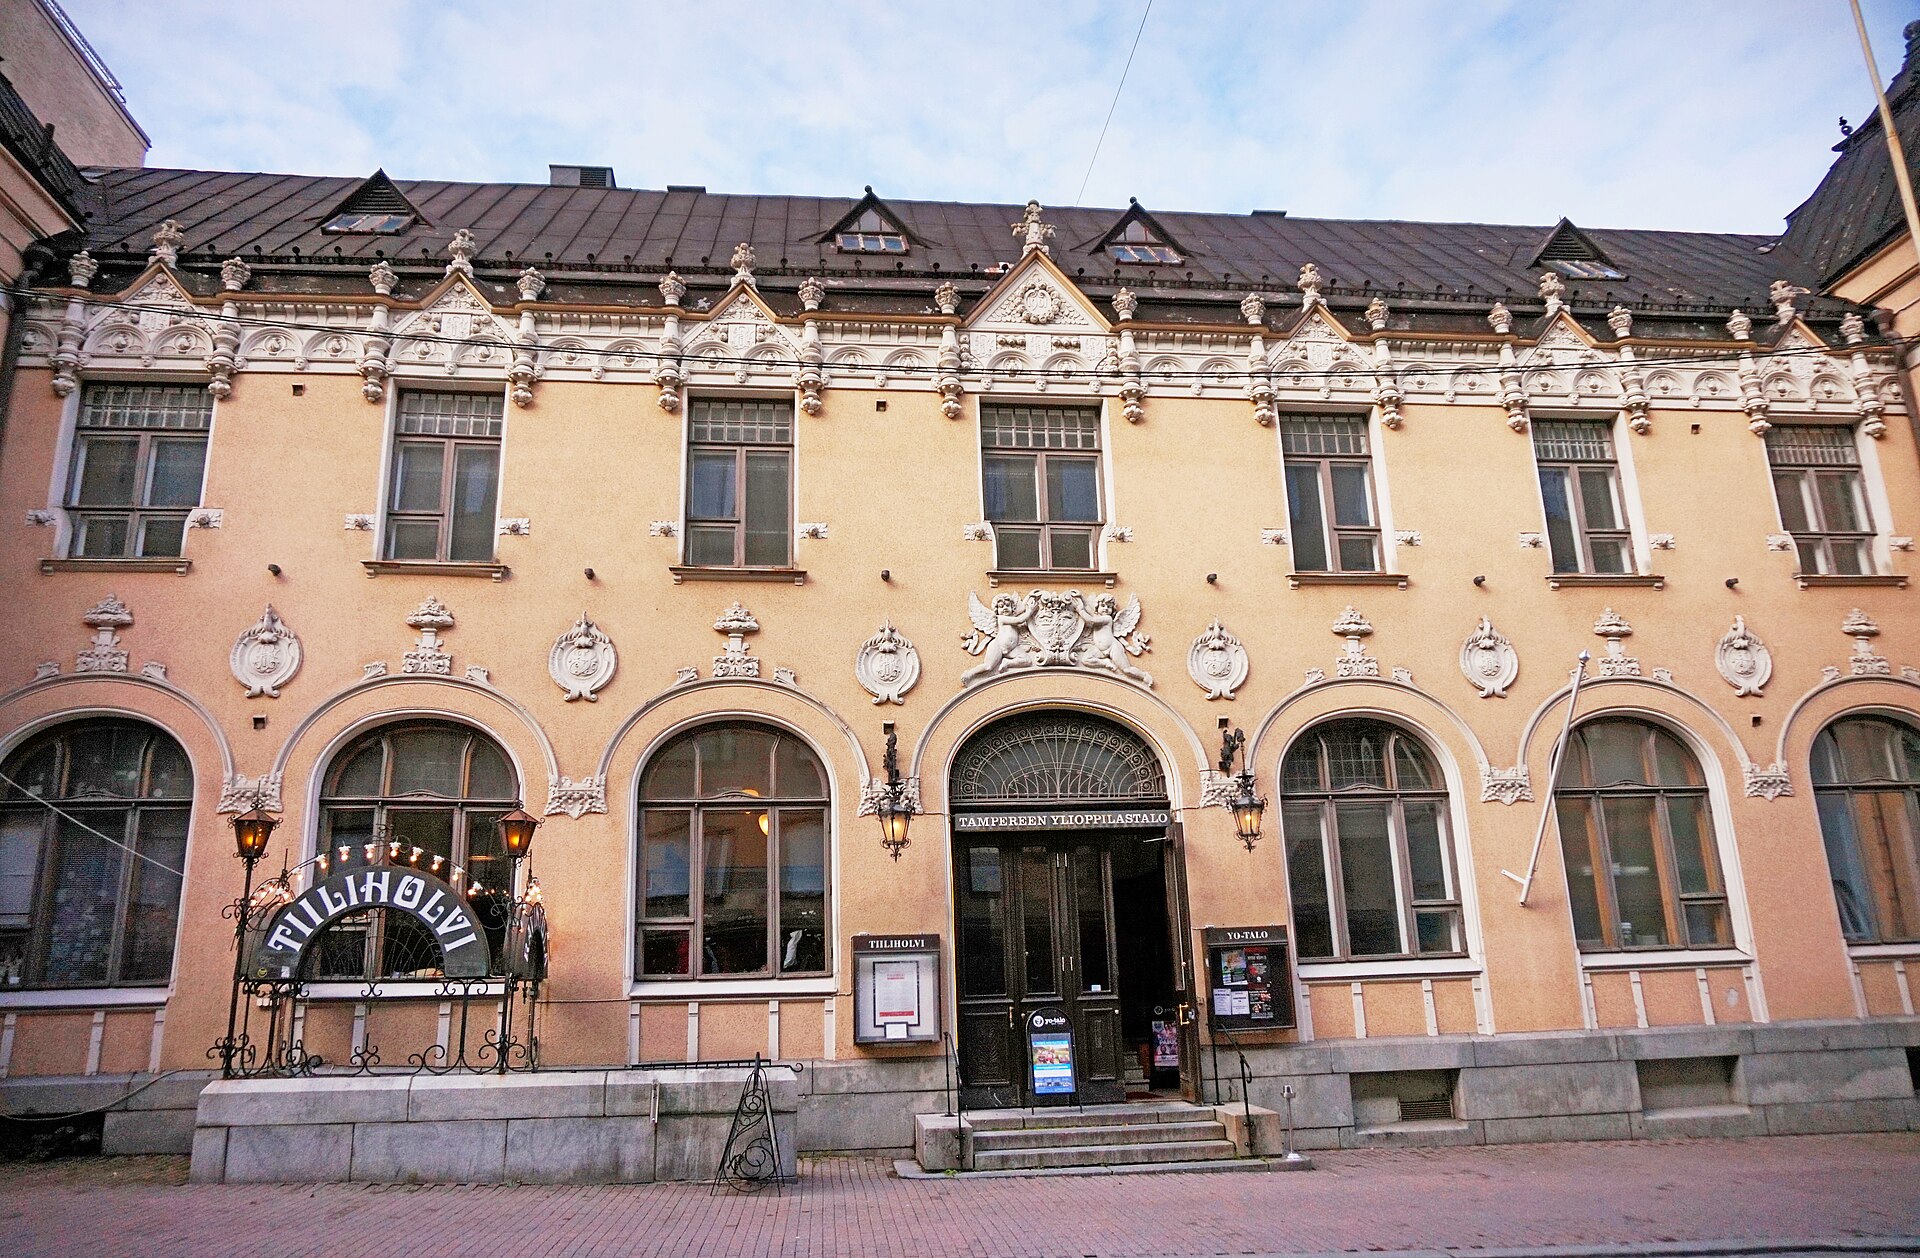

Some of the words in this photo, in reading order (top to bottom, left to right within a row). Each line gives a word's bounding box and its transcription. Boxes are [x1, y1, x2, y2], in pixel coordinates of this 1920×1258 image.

[959, 815, 1047, 827] TAMPEREEN
[1051, 813, 1168, 826] YLIOPPILASTALO
[267, 871, 478, 953] TIILIHOLVI
[1227, 931, 1269, 940] YO-TALO
[869, 939, 925, 948] TIILIHOLVI
[1045, 1016, 1066, 1024] yo-talo
